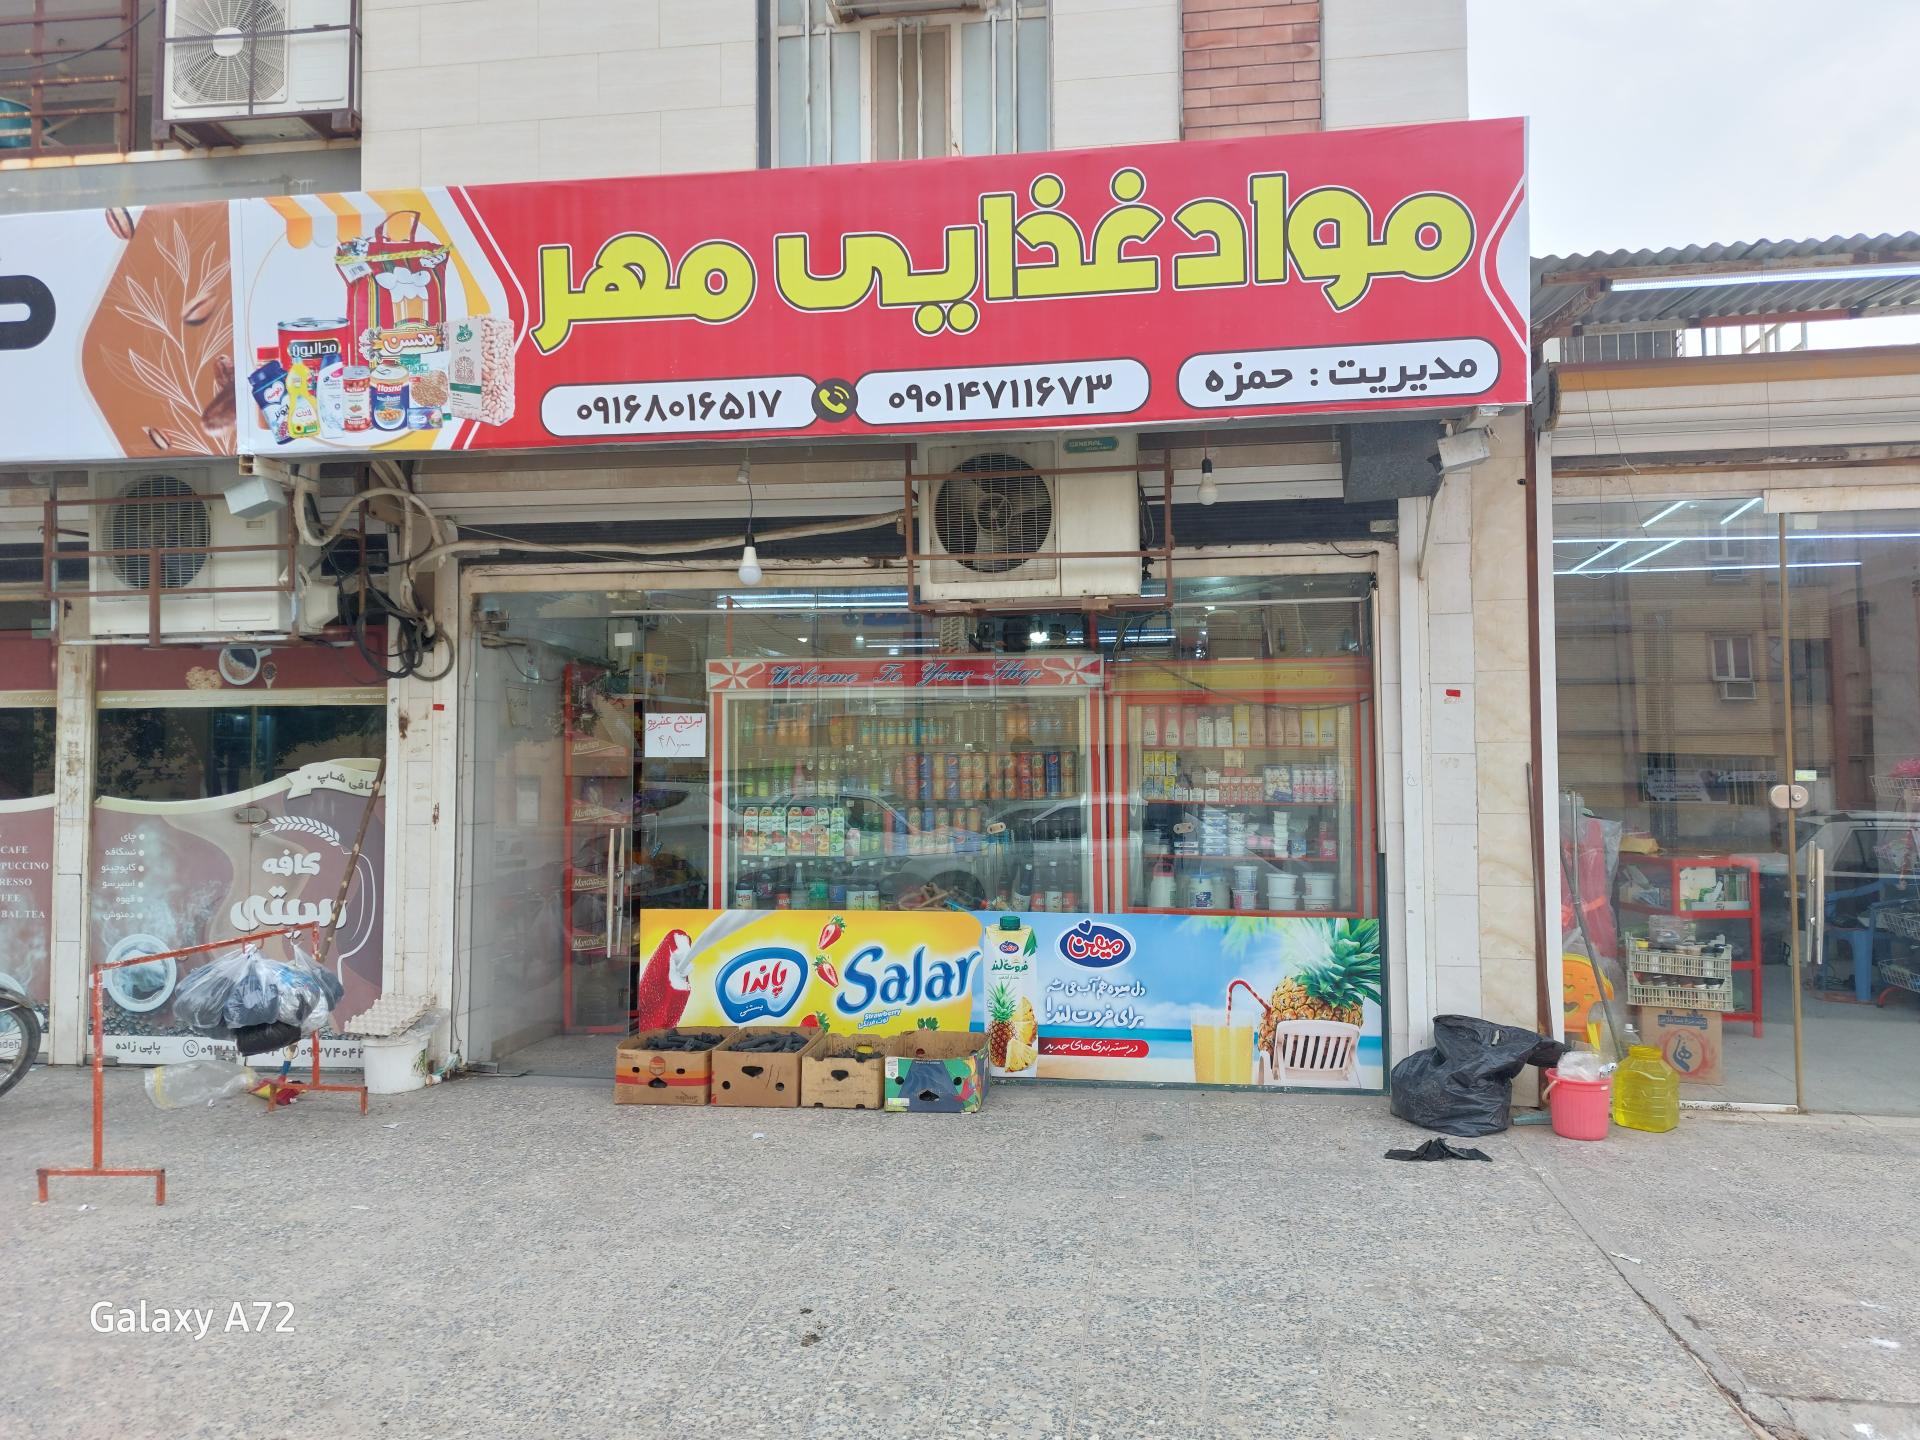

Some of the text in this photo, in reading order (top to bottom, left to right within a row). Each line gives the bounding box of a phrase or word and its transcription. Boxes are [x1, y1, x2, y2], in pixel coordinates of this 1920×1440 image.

[530, 167, 1476, 355] مواد غذایی مهر
[888, 373, 1113, 413] ۰۹۰۱۴۷۱۱۶۷۳
[1205, 361, 1293, 401] حمزه
[577, 389, 782, 425] ۰۹۱۶۸۰۱۶۵۱۷
[768, 659, 1045, 687] Welcome To Your Shop
[674, 715, 703, 733] برنج
[317, 770, 346, 785] شاپ
[120, 833, 137, 843] چای
[262, 848, 322, 877] کافه
[25, 910, 46, 919] TEA
[1067, 934, 1125, 959] میهن
[741, 960, 788, 998] پاندا
[836, 945, 983, 1014] Salar
[739, 1003, 765, 1017] بستنی
[864, 1008, 901, 1020] Strawberry
[1113, 1005, 1145, 1029] برای
[115, 1041, 161, 1055] پاپی زاده
